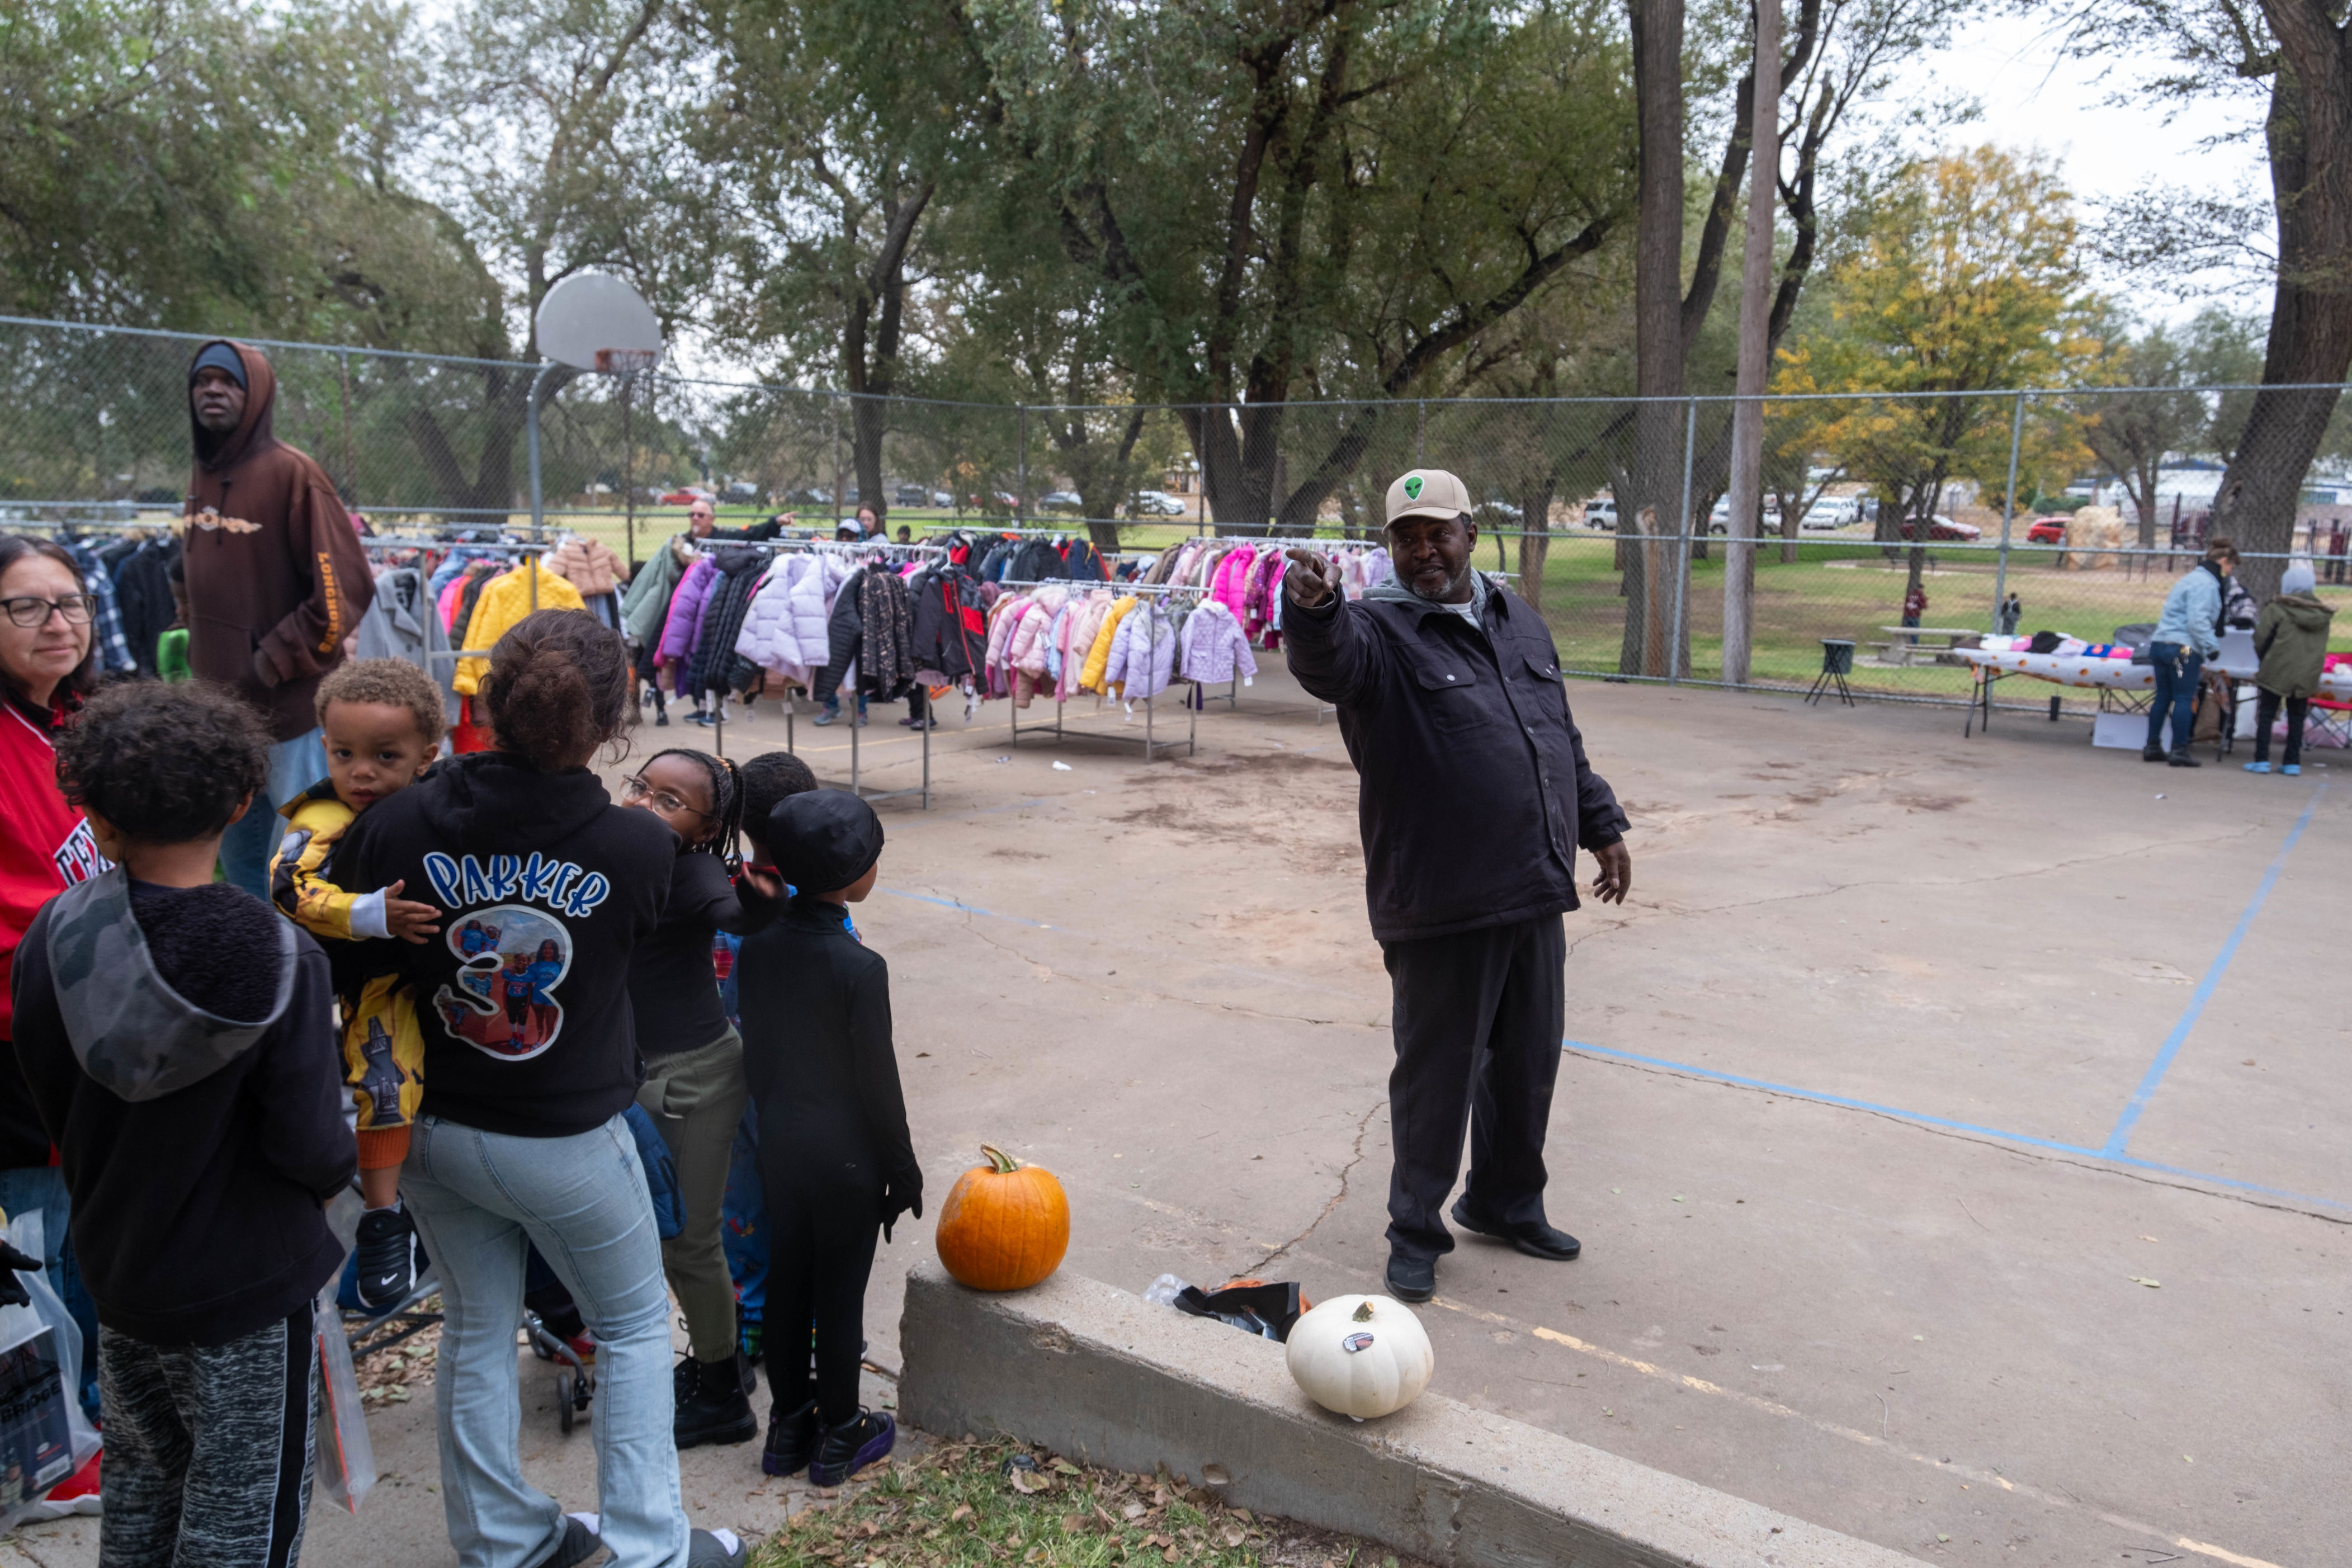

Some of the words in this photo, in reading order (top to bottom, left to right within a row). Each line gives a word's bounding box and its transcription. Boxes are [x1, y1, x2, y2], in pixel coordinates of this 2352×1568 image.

[317, 552, 339, 653] LONGHORNS
[423, 851, 610, 917] PARKER
[433, 904, 573, 1061] 3
[1, 1380, 61, 1423] BRIDGE
